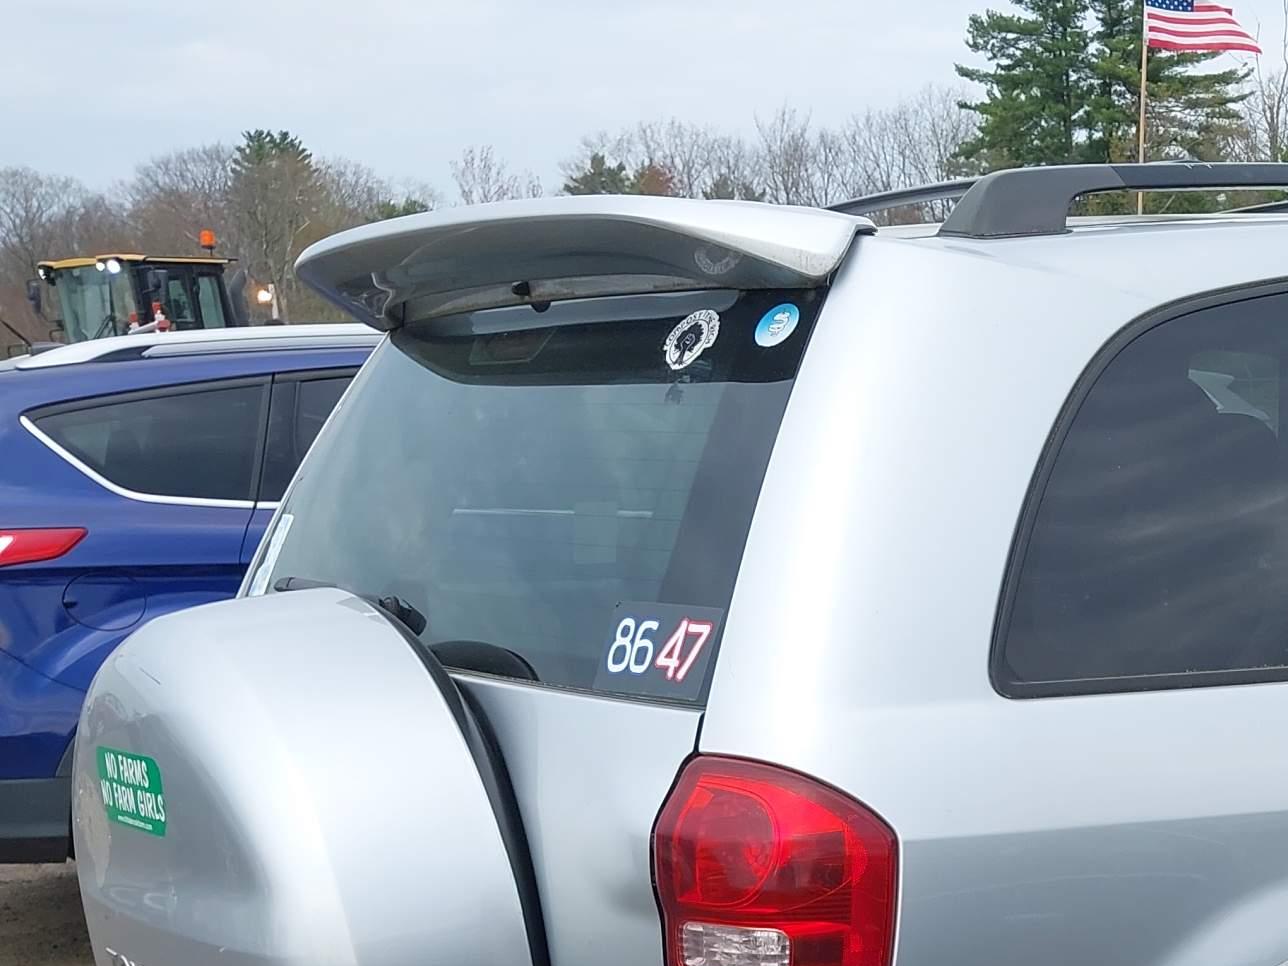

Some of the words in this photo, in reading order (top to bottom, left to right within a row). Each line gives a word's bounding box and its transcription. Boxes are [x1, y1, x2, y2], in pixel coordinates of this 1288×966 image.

[607, 617, 659, 674] 86
[655, 617, 712, 682] 47
[104, 752, 118, 779] NO
[117, 754, 149, 788] FARMS
[101, 779, 113, 807] NO
[112, 782, 136, 814] FARM
[137, 789, 165, 822] GIRLS
